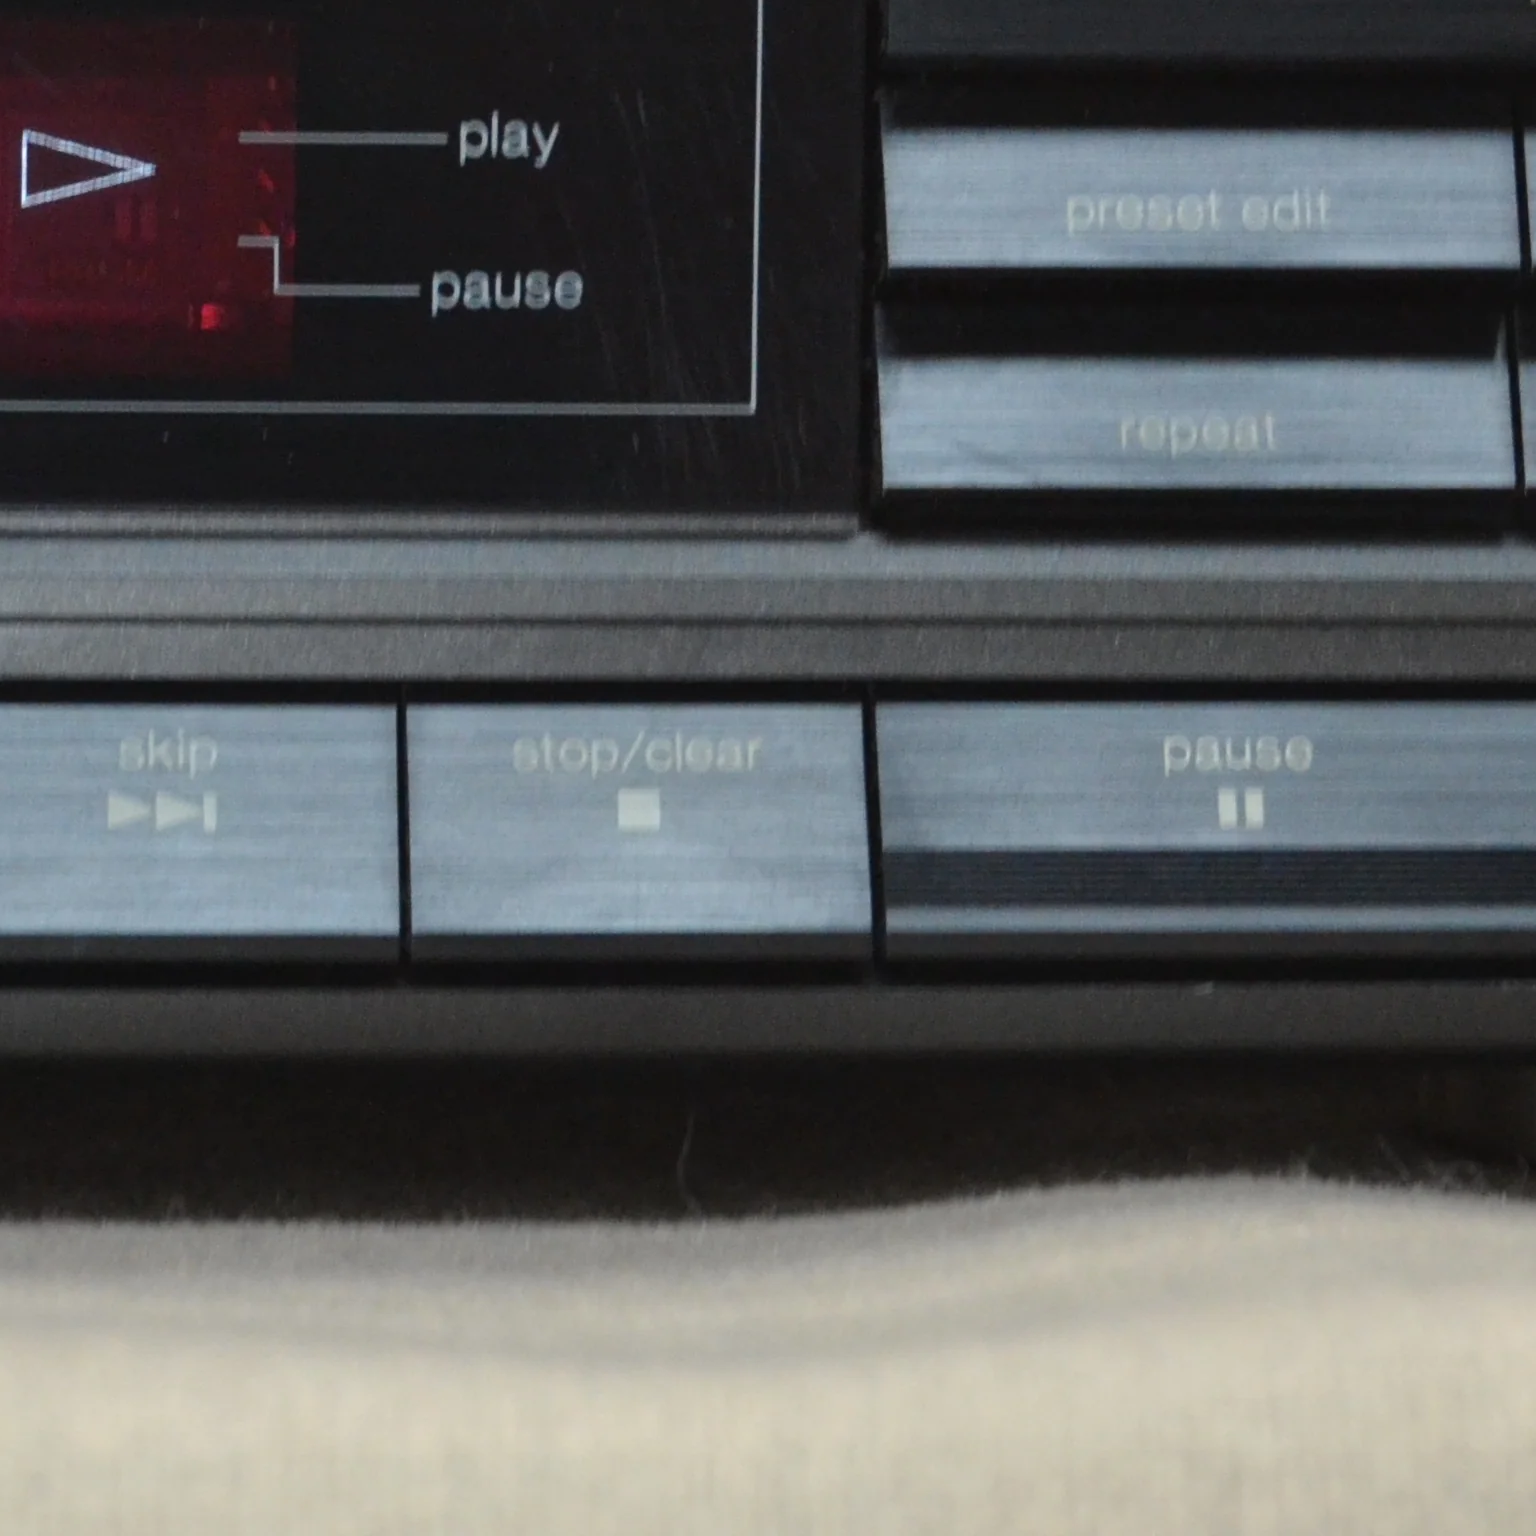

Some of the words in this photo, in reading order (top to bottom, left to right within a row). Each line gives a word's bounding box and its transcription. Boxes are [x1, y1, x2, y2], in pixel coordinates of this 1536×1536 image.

[458, 111, 561, 167] play
[1065, 188, 1221, 235] preset
[1241, 188, 1332, 230] edit
[430, 267, 584, 318] pause
[1119, 410, 1277, 458] repeat
[118, 728, 219, 779] skip
[511, 730, 763, 777] stop/clear
[1161, 731, 1314, 779] pause
